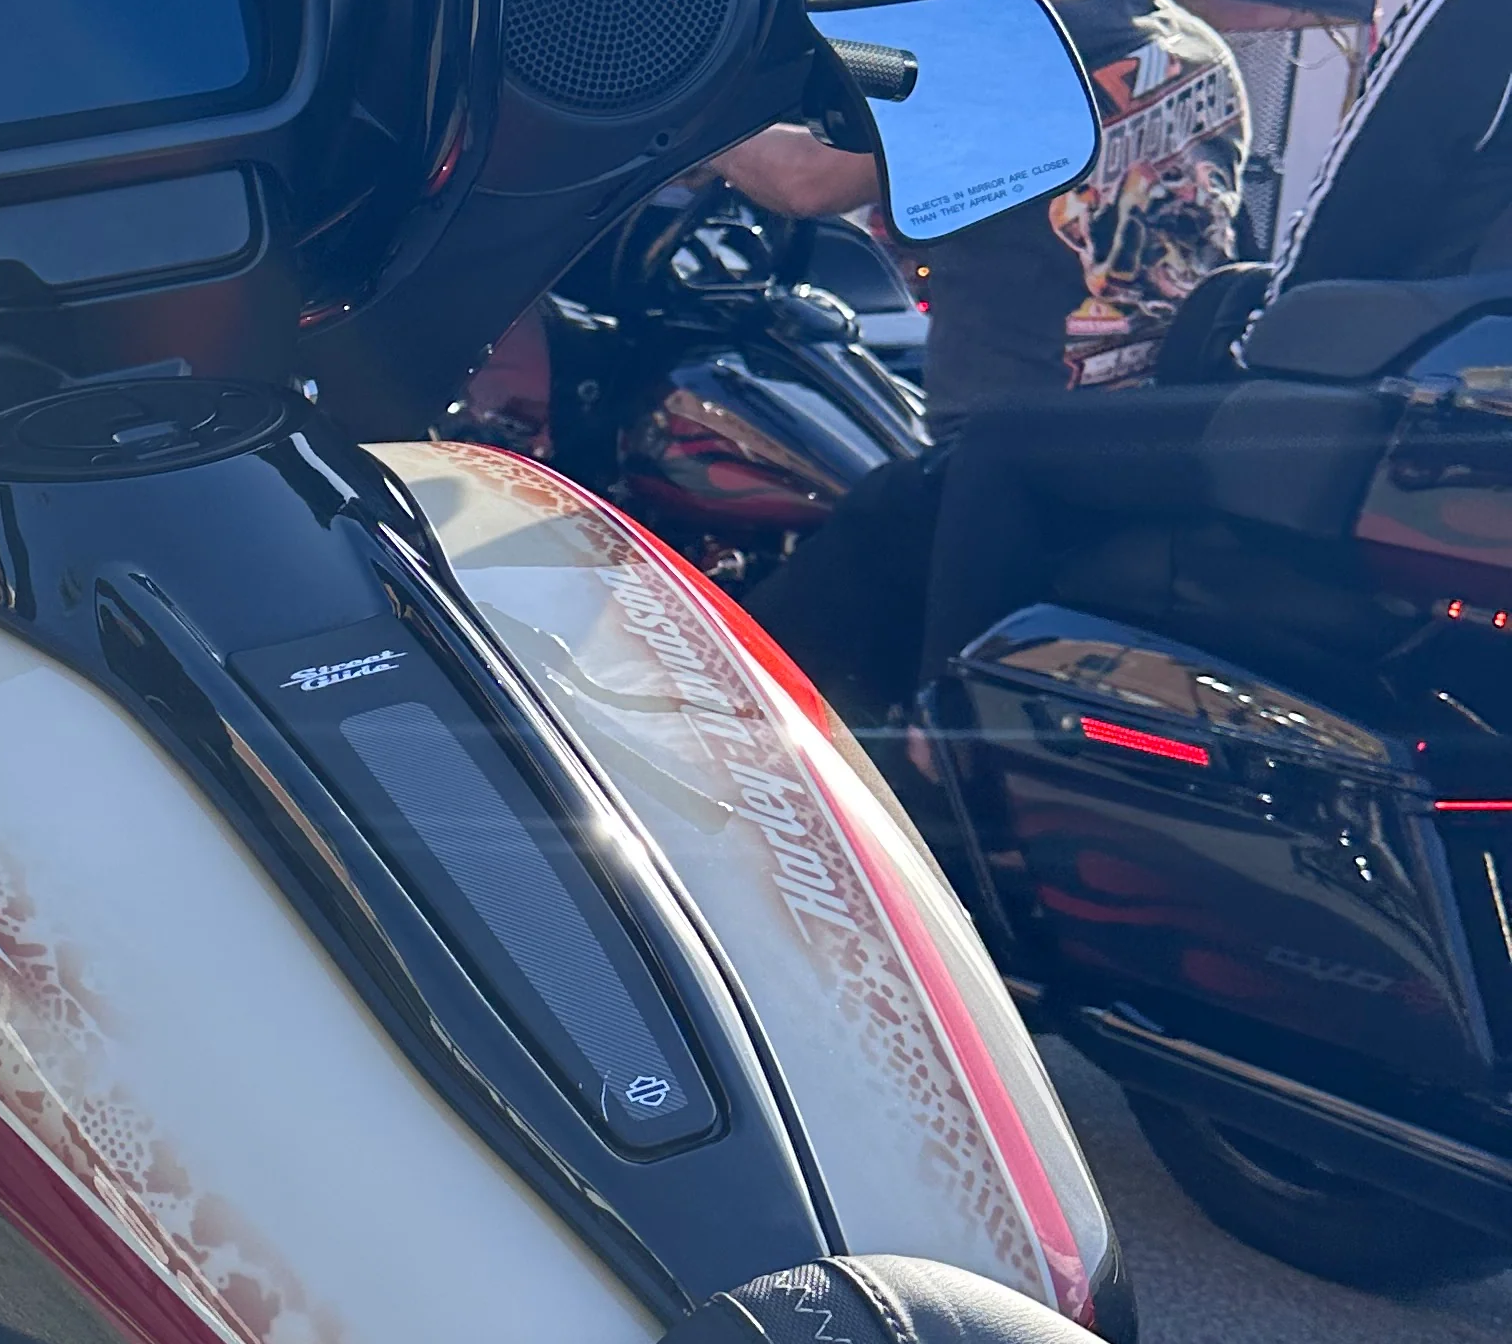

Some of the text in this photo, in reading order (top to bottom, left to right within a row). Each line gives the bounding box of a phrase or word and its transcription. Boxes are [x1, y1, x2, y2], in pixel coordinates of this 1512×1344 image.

[906, 157, 1070, 215] OBJECTS IN MIRROR ARE CLOSER
[909, 189, 1008, 227] THAN THEY APPEAR
